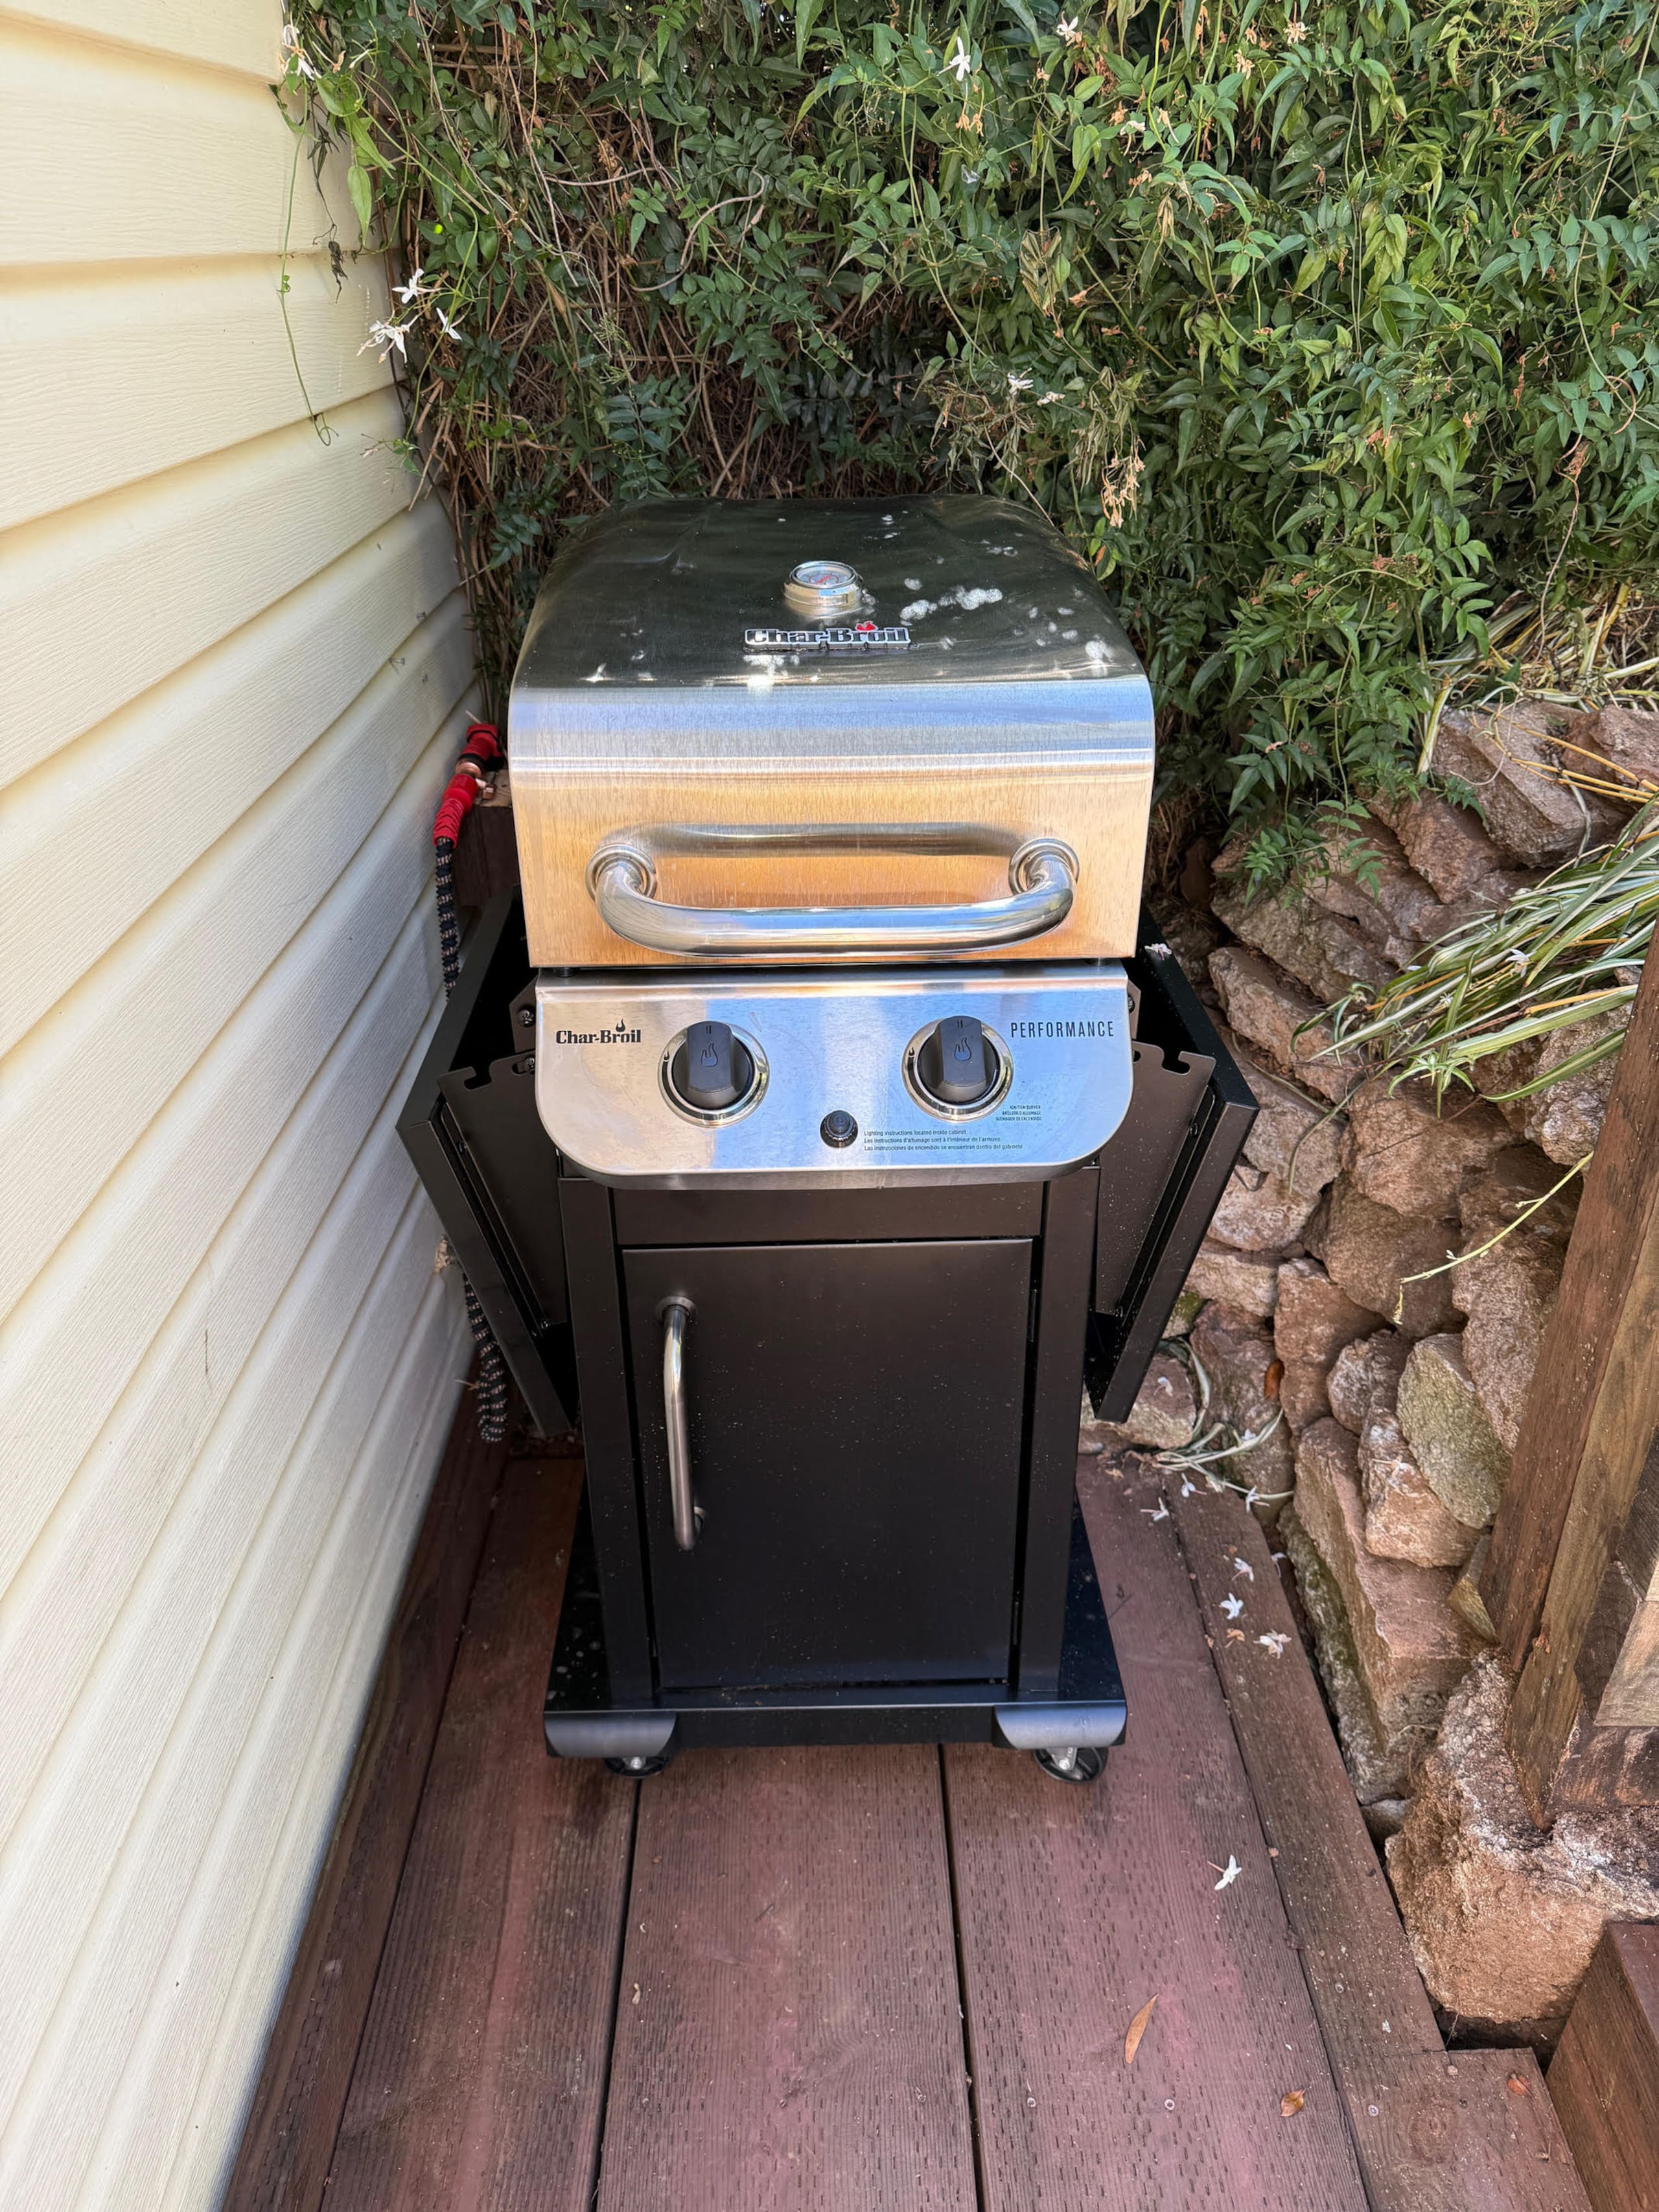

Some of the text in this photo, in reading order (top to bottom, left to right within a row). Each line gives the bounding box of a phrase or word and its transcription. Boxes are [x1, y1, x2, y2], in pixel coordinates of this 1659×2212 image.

[745, 628, 911, 647] Char-Broil
[555, 1029, 642, 1044] Char-Broil
[1010, 1021, 1114, 1038] PERFORMANCE
